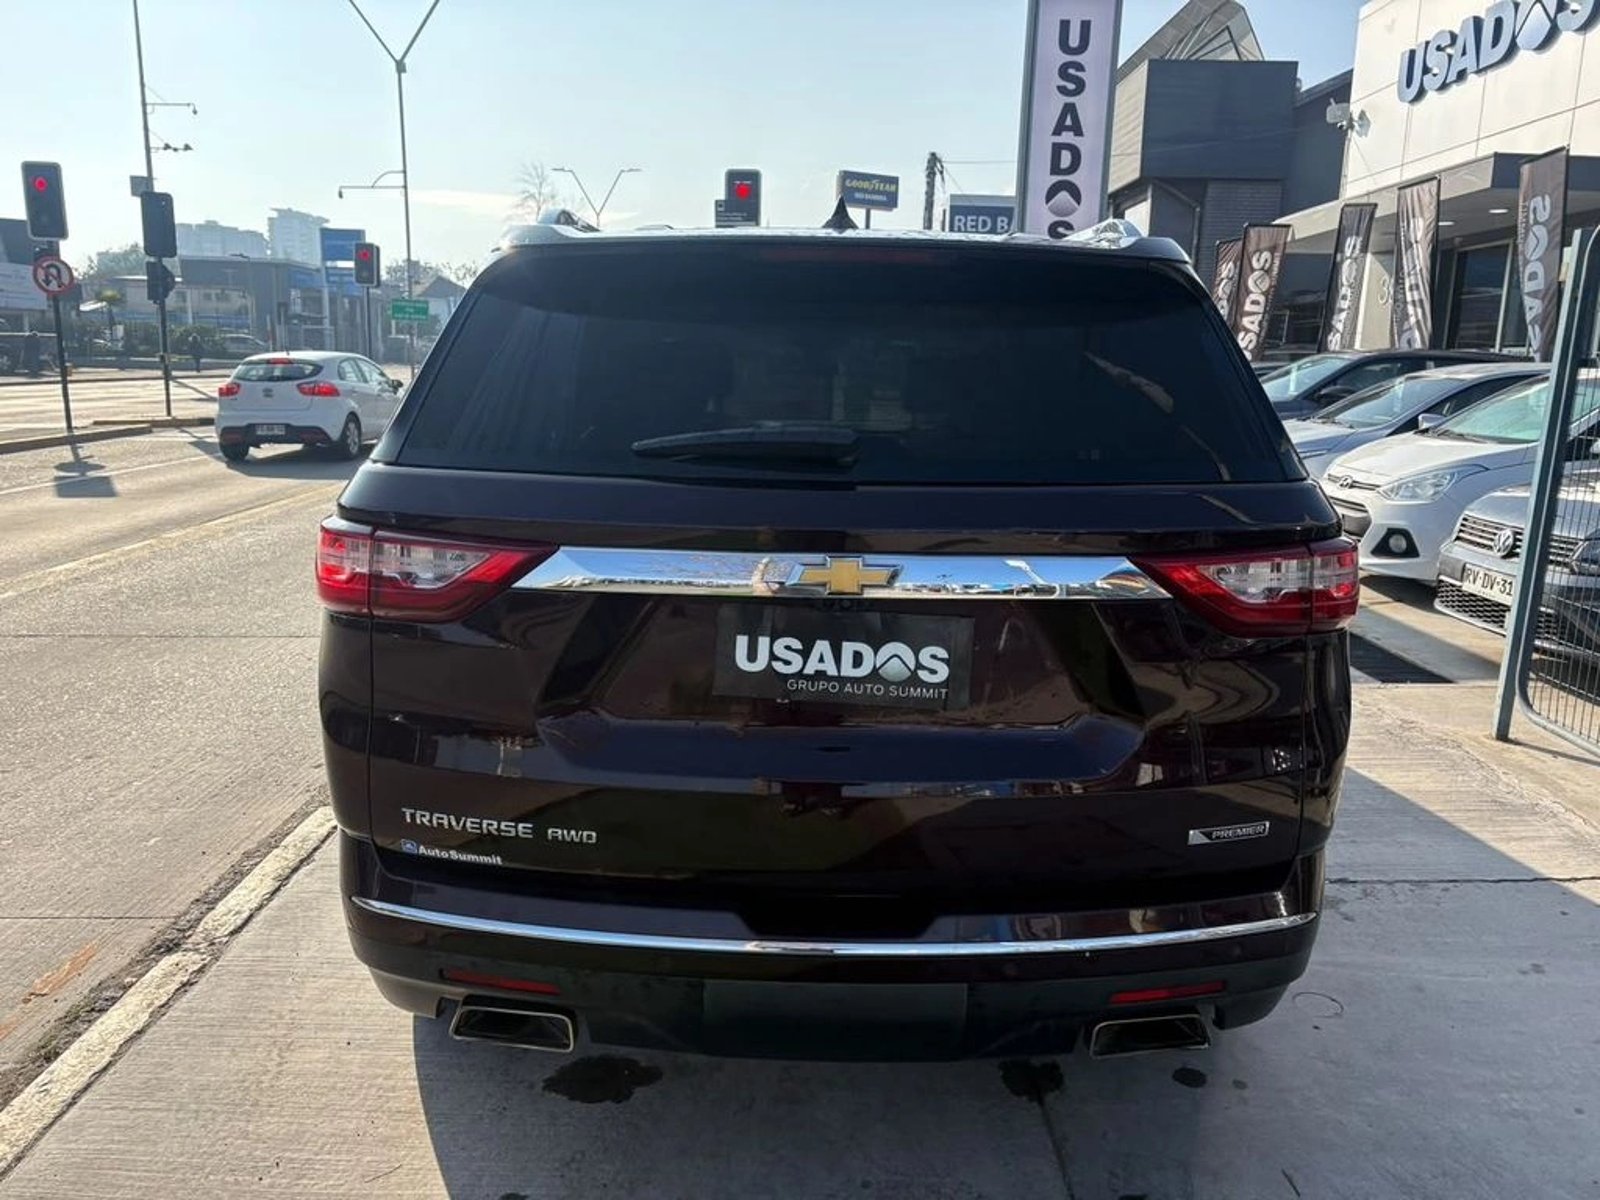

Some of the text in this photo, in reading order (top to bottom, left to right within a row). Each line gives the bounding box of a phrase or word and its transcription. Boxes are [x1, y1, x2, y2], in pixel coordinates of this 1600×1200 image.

[954, 215, 991, 232] RED
[735, 633, 951, 685] USADOS
[786, 679, 950, 701] GRUPO AUTO SUMMIT
[401, 807, 598, 844] TRAVERSE AWD
[1211, 825, 1265, 839] PREMIER
